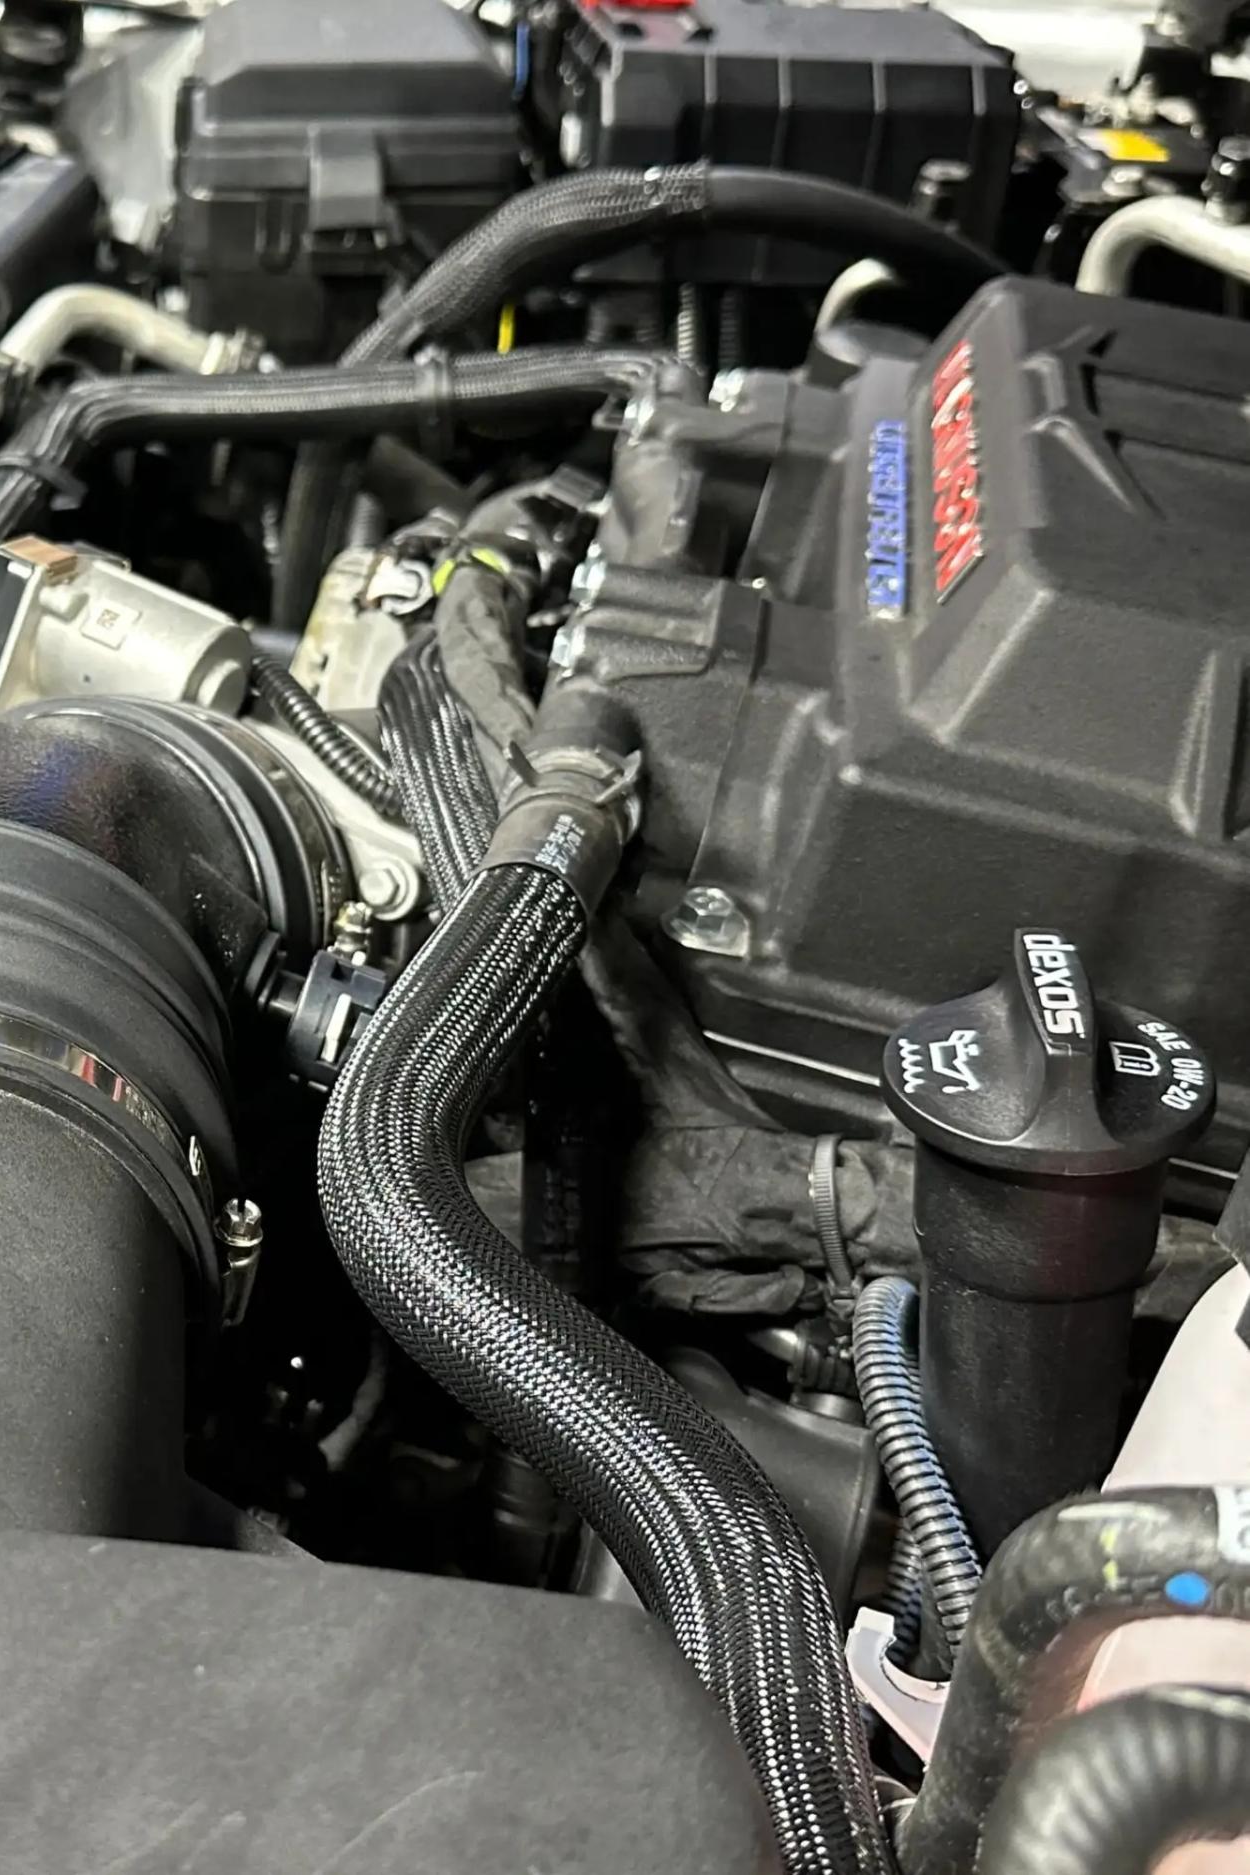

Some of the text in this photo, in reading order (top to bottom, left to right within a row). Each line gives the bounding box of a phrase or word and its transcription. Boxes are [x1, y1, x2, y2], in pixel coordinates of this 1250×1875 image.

[1022, 933, 1085, 1038] dexos
[1137, 1020, 1208, 1111] SAE 0W-20
